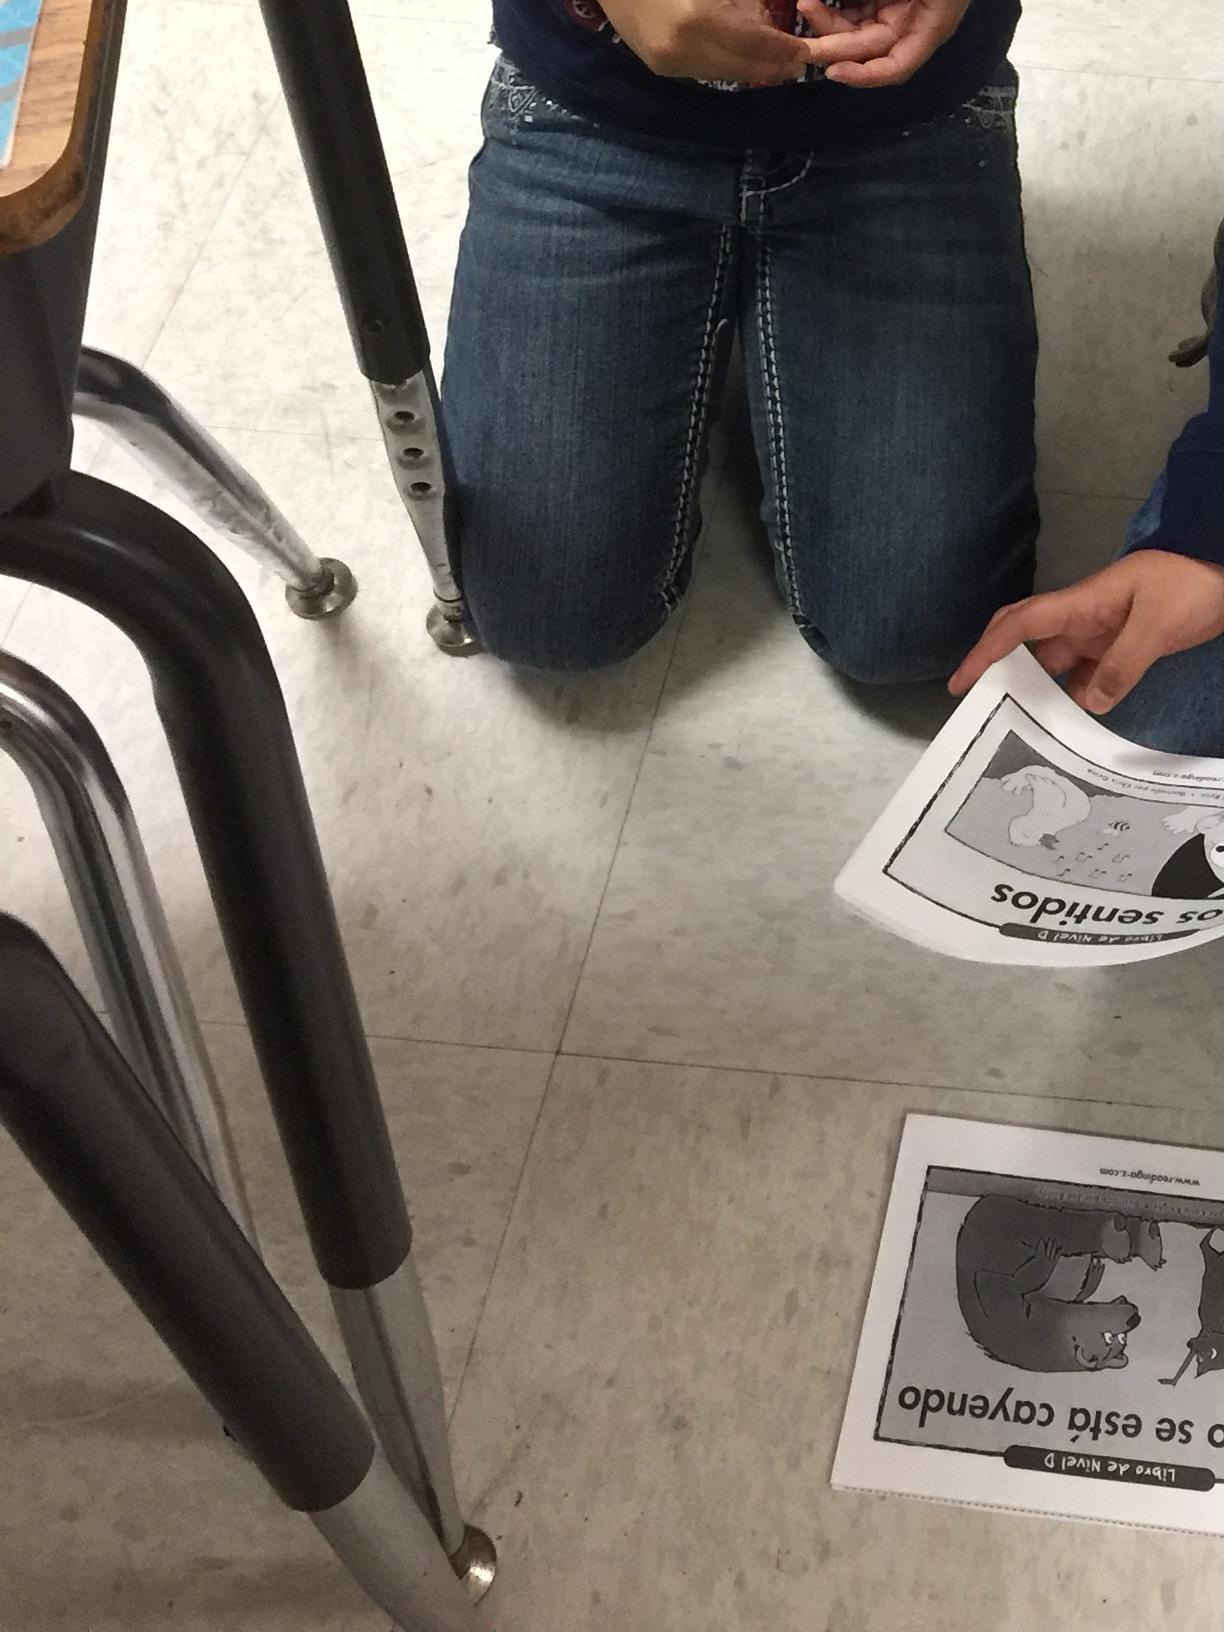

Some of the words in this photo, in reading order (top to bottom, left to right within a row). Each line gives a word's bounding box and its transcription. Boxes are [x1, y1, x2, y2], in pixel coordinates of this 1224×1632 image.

[990, 884, 1165, 926] sentidos
[1037, 929, 1049, 940] D
[1053, 932, 1093, 943] Nivel
[1099, 1168, 1201, 1187] www.readinga-z.com
[898, 1386, 1055, 1428] cayendo
[1068, 1406, 1143, 1443] está
[1155, 1417, 1195, 1446] se
[1044, 1452, 1056, 1469] D
[1061, 1456, 1101, 1473] Nivel
[1107, 1461, 1130, 1476] de
[1135, 1464, 1176, 1483] Libro
